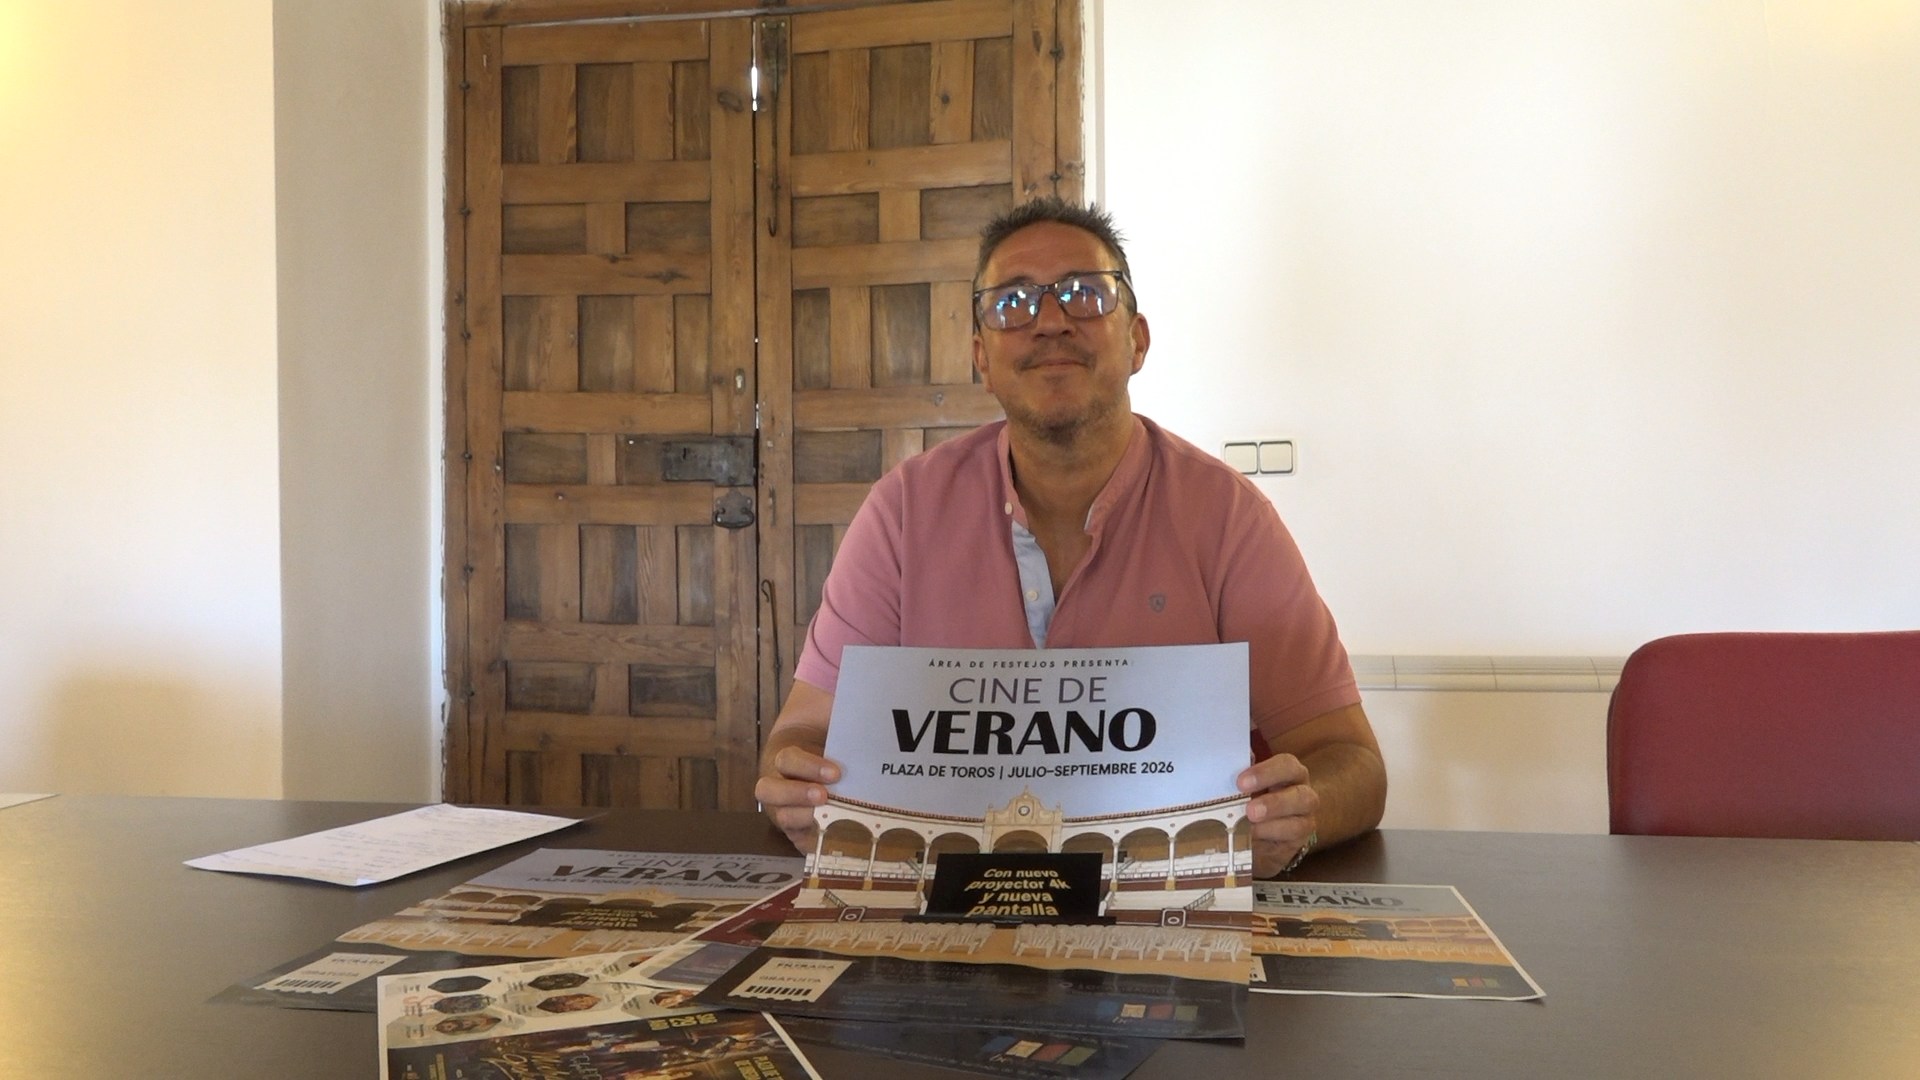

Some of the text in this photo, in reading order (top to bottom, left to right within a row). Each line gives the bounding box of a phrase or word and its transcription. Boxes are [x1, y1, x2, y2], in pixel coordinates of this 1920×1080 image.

[928, 658, 961, 668] ÁREA
[969, 660, 985, 668] DE
[993, 660, 1055, 669] FESTEJOS
[949, 676, 1107, 704] CINE DE
[891, 706, 1157, 755] VERANO
[881, 763, 924, 776] PLAZA
[928, 765, 946, 777] DE
[950, 766, 995, 778] TOROS
[1141, 761, 1174, 774] 2026
[553, 865, 793, 884] VERANO
[983, 868, 1059, 878] Con nuevo
[964, 878, 1071, 892] proyector 4k
[978, 892, 1054, 904] y nueva
[1256, 893, 1403, 906] ERANO
[964, 903, 1059, 918] pantalla
